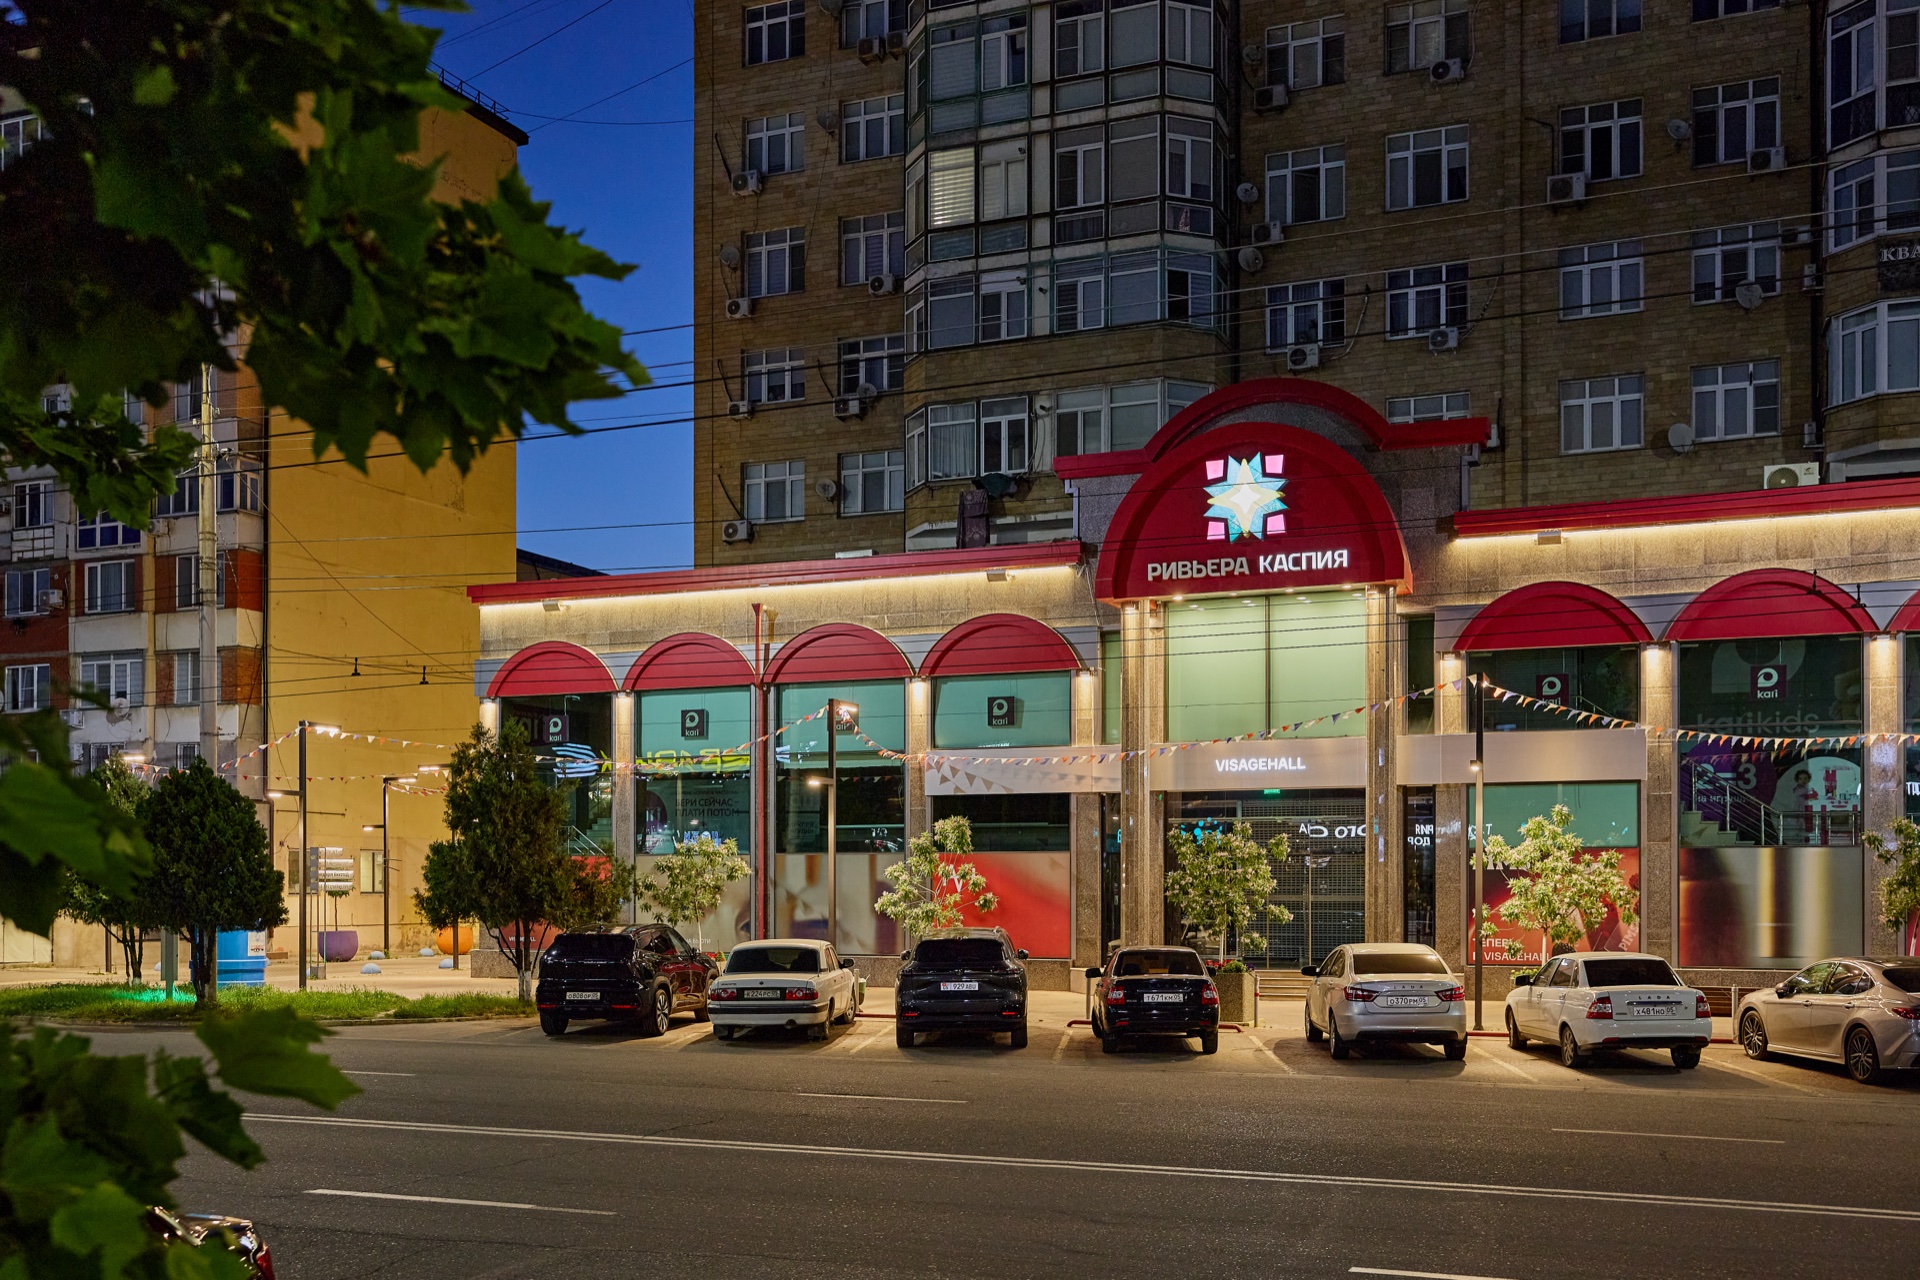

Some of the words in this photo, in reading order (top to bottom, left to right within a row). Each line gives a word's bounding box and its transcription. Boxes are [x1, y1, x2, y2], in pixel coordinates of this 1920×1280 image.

[1147, 557, 1250, 582] РИВЬЕРА
[1258, 549, 1348, 573] КАСПИЯ
[1757, 688, 1778, 699] kari
[992, 717, 1008, 726] kari
[685, 728, 699, 737] kari
[549, 734, 562, 742] kari
[1215, 756, 1306, 772] VISAGEHALL
[698, 796, 733, 807] СЕЙЧАС
[706, 808, 740, 817] ПОТОМ
